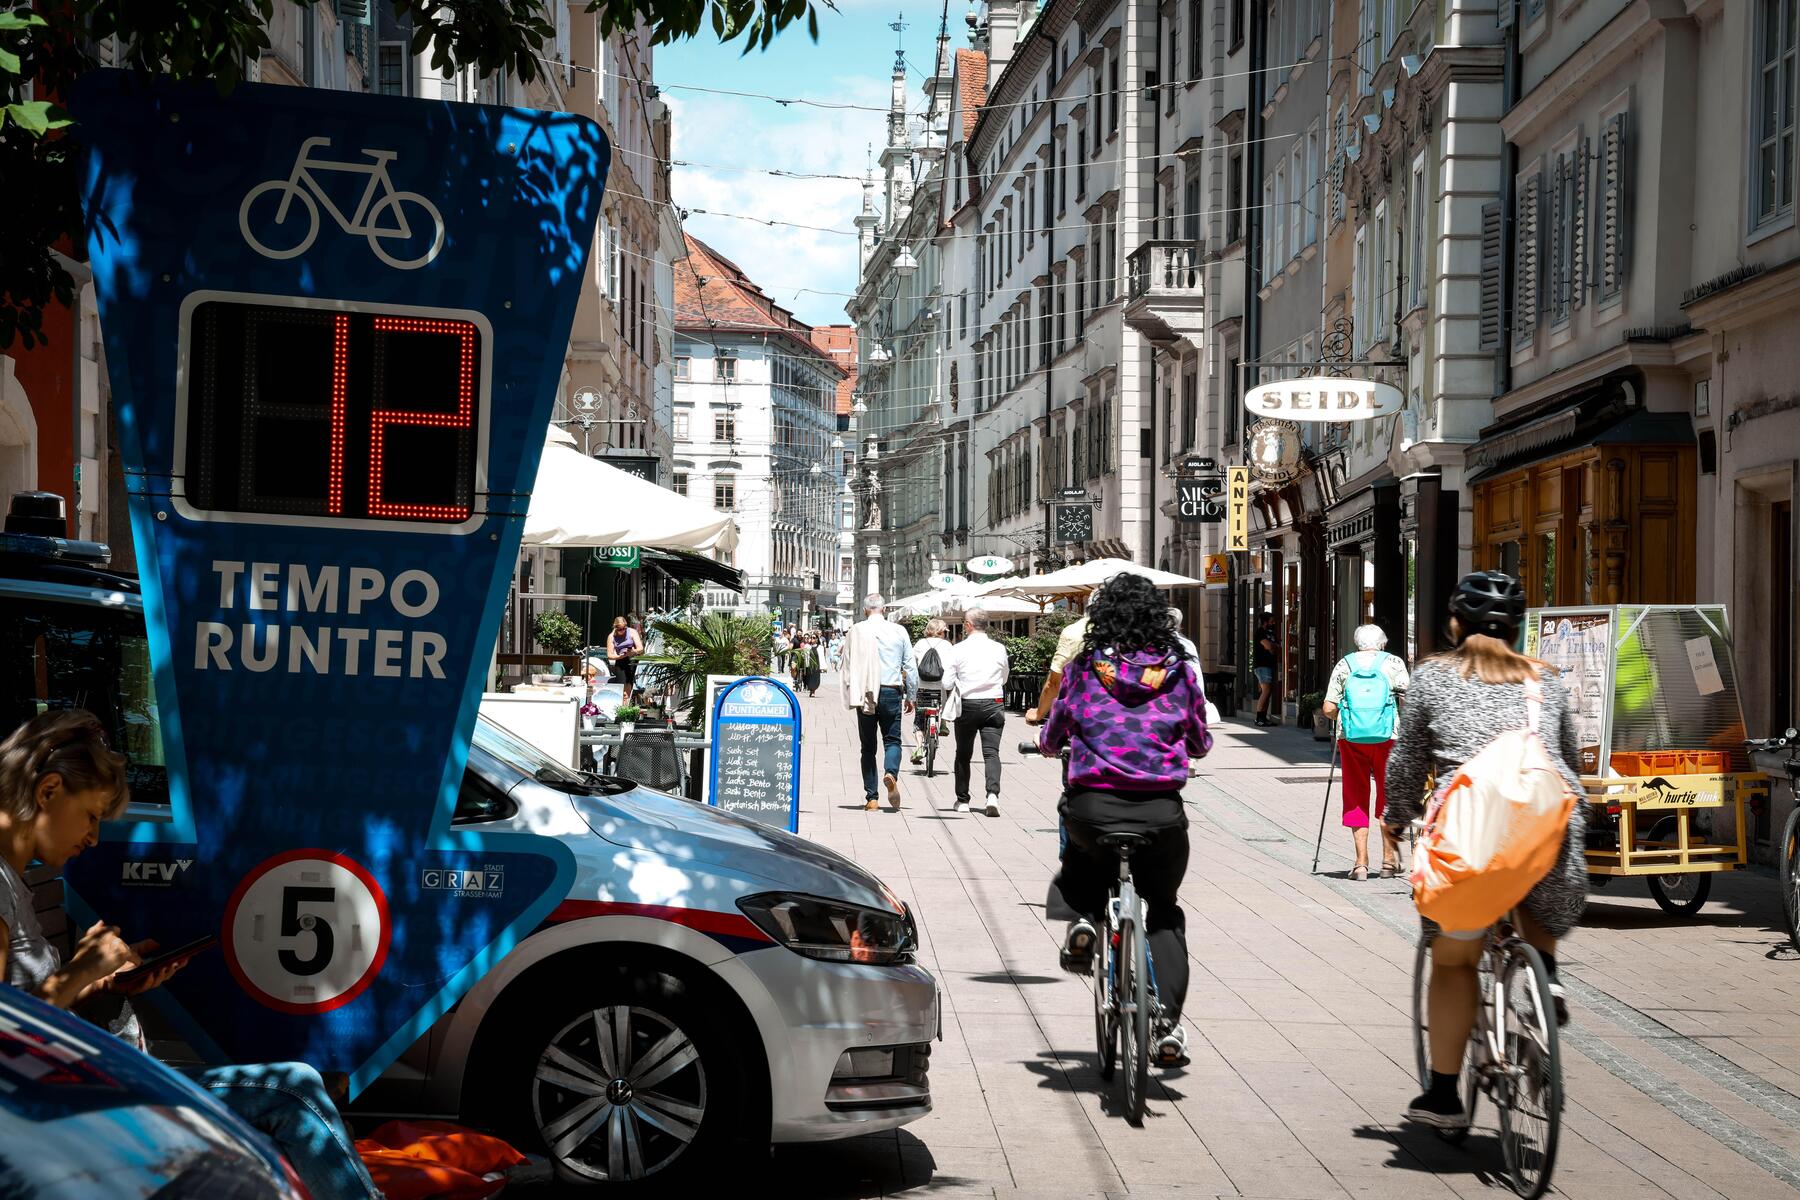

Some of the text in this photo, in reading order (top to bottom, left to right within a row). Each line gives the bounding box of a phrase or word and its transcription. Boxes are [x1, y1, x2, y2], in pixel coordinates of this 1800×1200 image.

[1262, 391, 1384, 410] SEIDL
[329, 315, 474, 519] 12
[1255, 420, 1297, 433] TRACHTEN
[1258, 469, 1296, 481] SEIDL
[1233, 471, 1245, 547] ANTIK
[212, 560, 440, 618] TEMPO
[707, 593, 739, 606] BILLA
[194, 621, 447, 679] RUNTER
[728, 705, 785, 715] PUNTIGAMER
[743, 788, 766, 799] Bento
[123, 862, 178, 881] KFV
[423, 870, 502, 890] GRAZ
[454, 890, 503, 899] STRASSENAMT
[278, 886, 336, 977] 5
